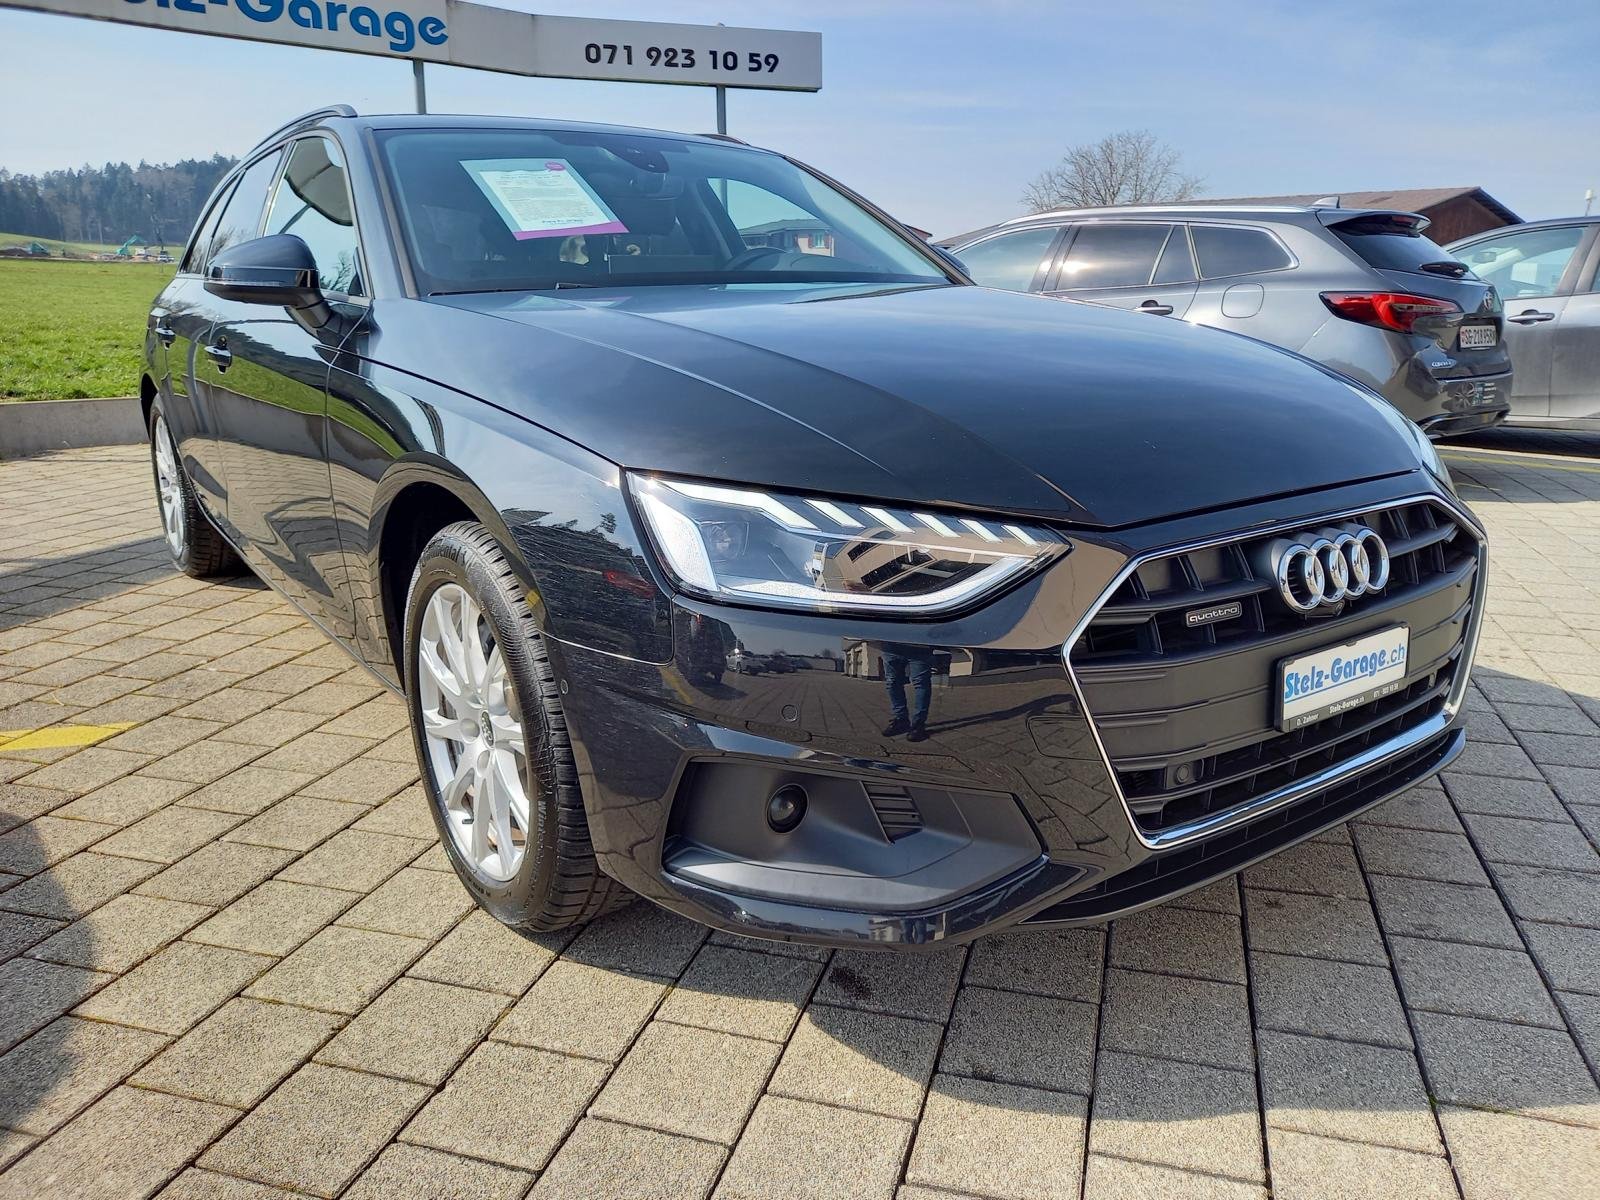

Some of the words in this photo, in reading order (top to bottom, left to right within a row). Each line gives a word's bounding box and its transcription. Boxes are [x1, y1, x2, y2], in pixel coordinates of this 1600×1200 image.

[124, 0, 449, 52] -Garage
[584, 43, 633, 65] 071
[646, 46, 696, 68] 923
[709, 50, 738, 71] 10
[748, 52, 780, 73] 59
[1189, 606, 1238, 623] quattro
[1285, 643, 1406, 699] Stelz-Garage.ch
